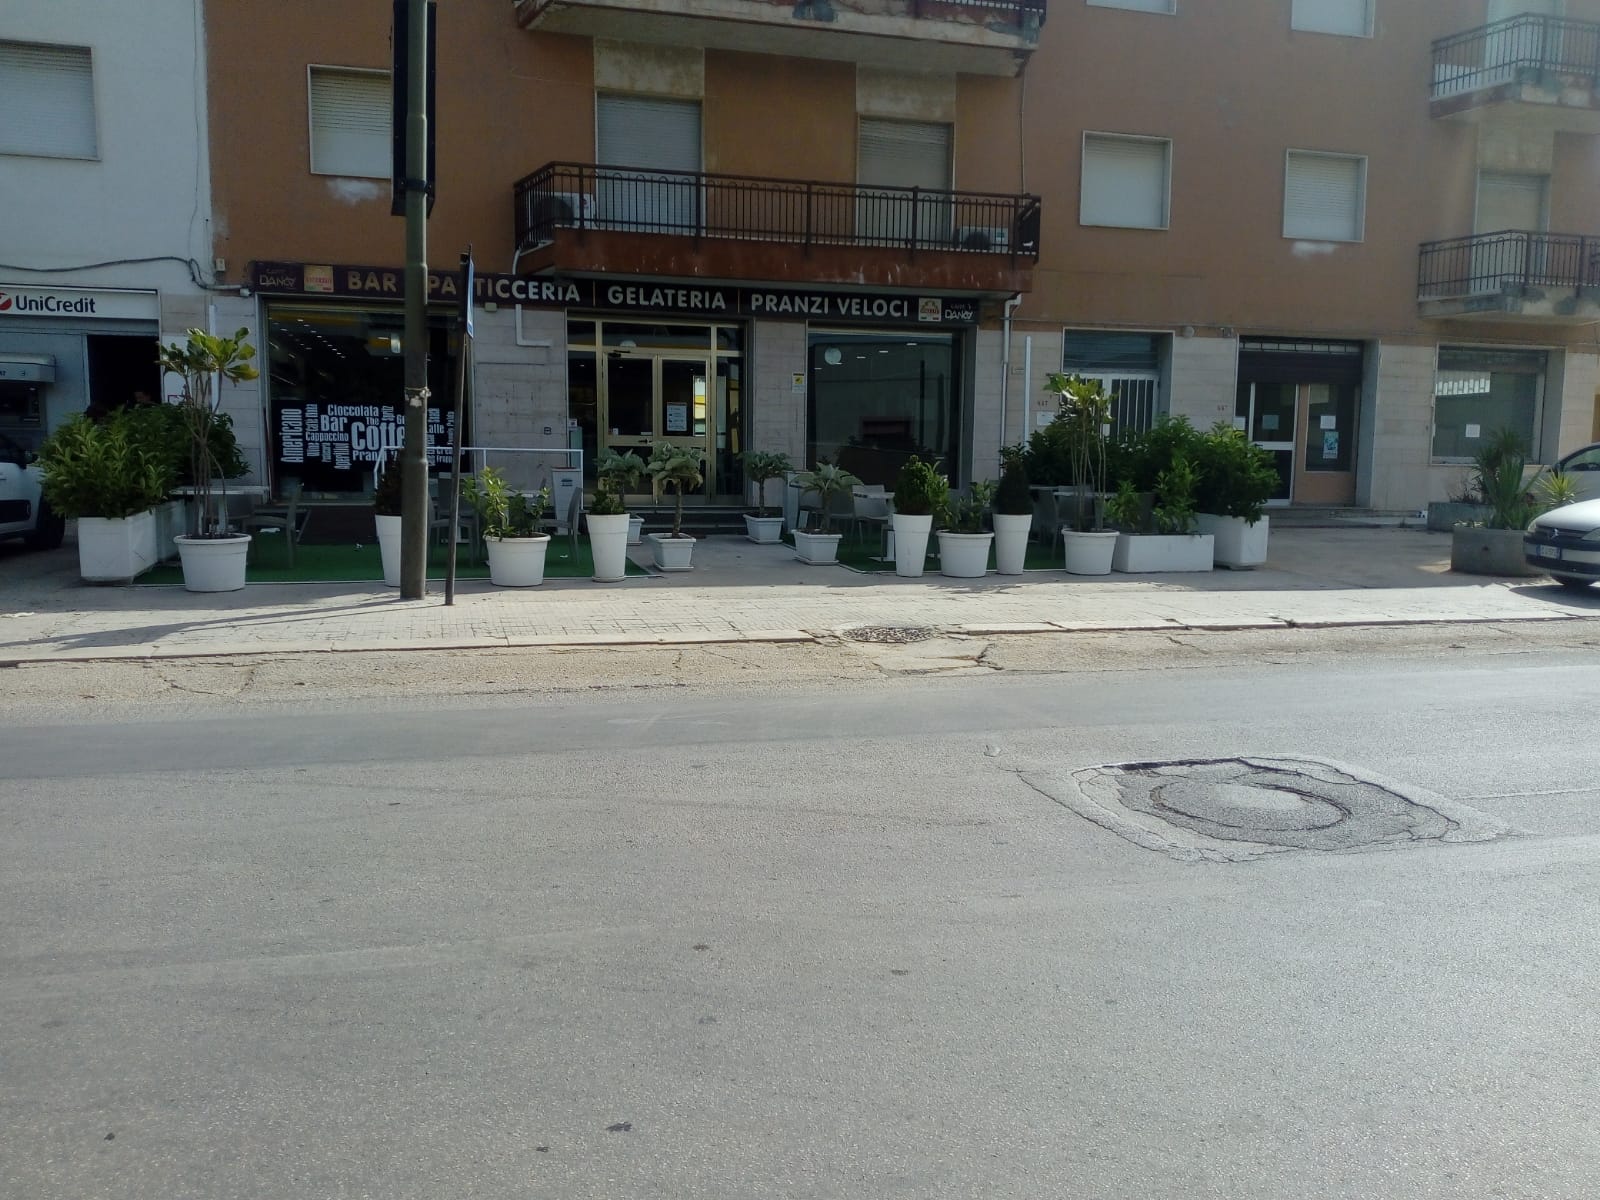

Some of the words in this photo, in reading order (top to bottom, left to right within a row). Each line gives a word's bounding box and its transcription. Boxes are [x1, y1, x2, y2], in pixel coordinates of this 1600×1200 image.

[347, 270, 397, 293] BAR
[427, 274, 581, 303] PATICCERIA
[607, 285, 726, 310] GELATERIA
[15, 295, 96, 313] UniCredit
[751, 293, 829, 315] PRANZI
[837, 297, 908, 318] VELOCI
[320, 414, 348, 432] Bar
[327, 404, 379, 417] Cioccolata
[279, 408, 304, 463] Americano
[305, 431, 349, 442] Cappuccino
[351, 421, 405, 451] Coffe
[333, 442, 352, 470] Aperitivi
